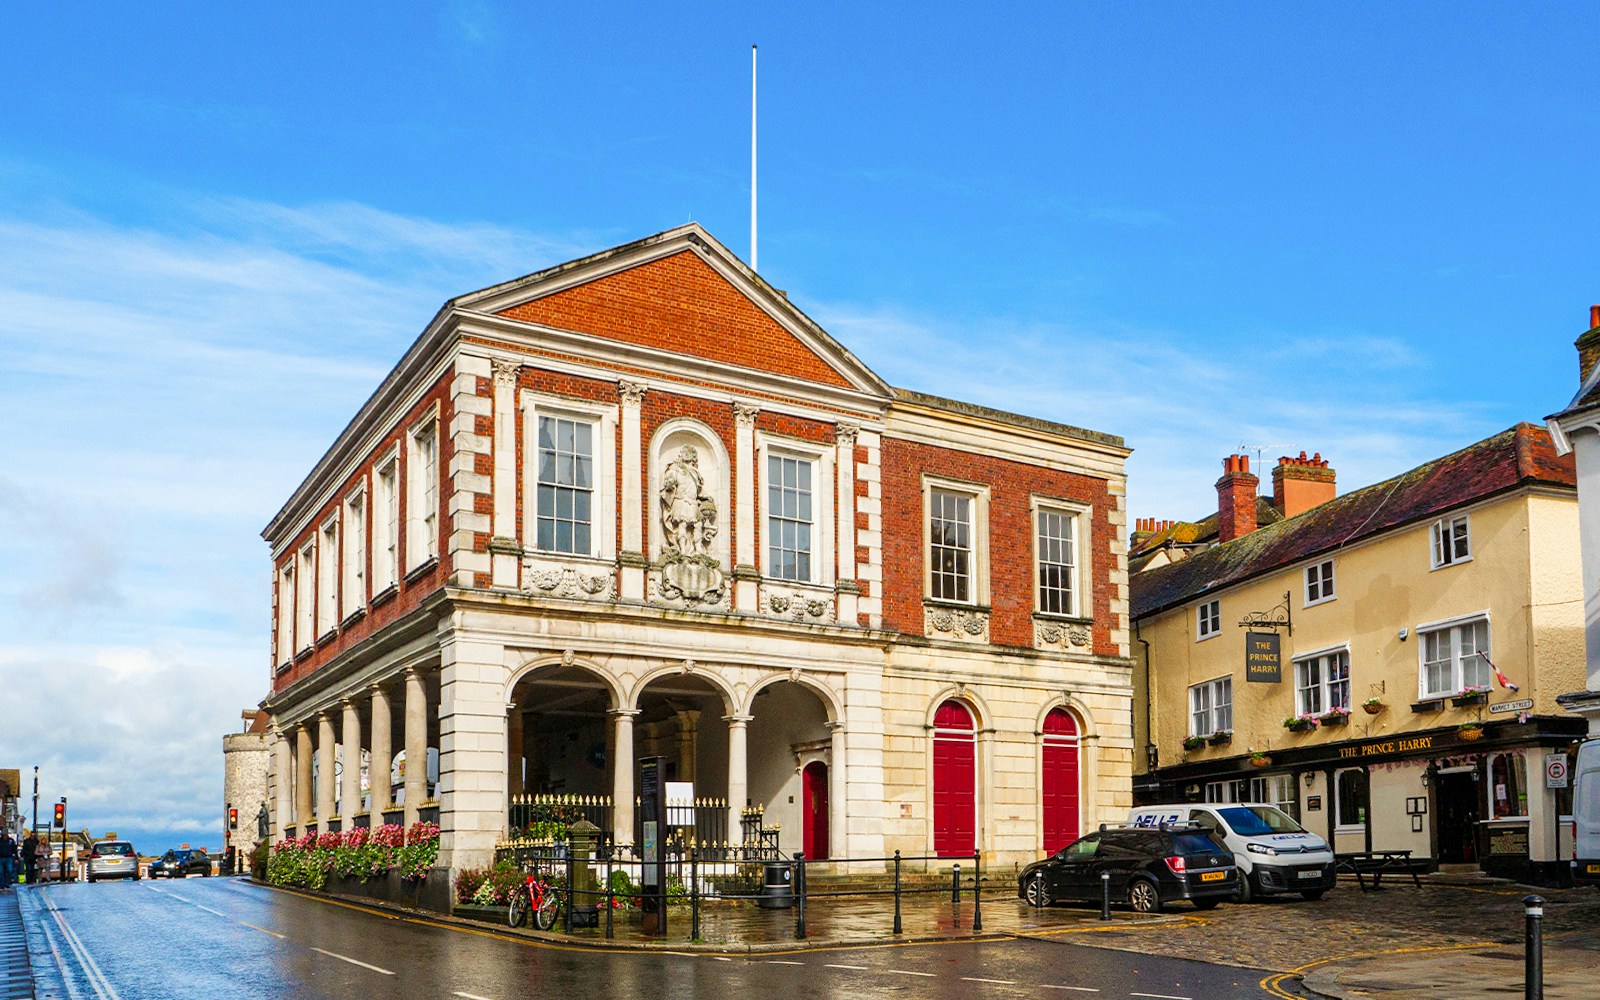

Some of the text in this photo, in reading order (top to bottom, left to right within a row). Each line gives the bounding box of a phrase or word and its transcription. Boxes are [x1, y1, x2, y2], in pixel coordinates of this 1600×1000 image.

[1255, 641, 1271, 650] THE
[1249, 653, 1278, 662] PRINCE
[1250, 665, 1278, 673] HARRY
[1339, 737, 1432, 758] THE PRINCE HARRY
